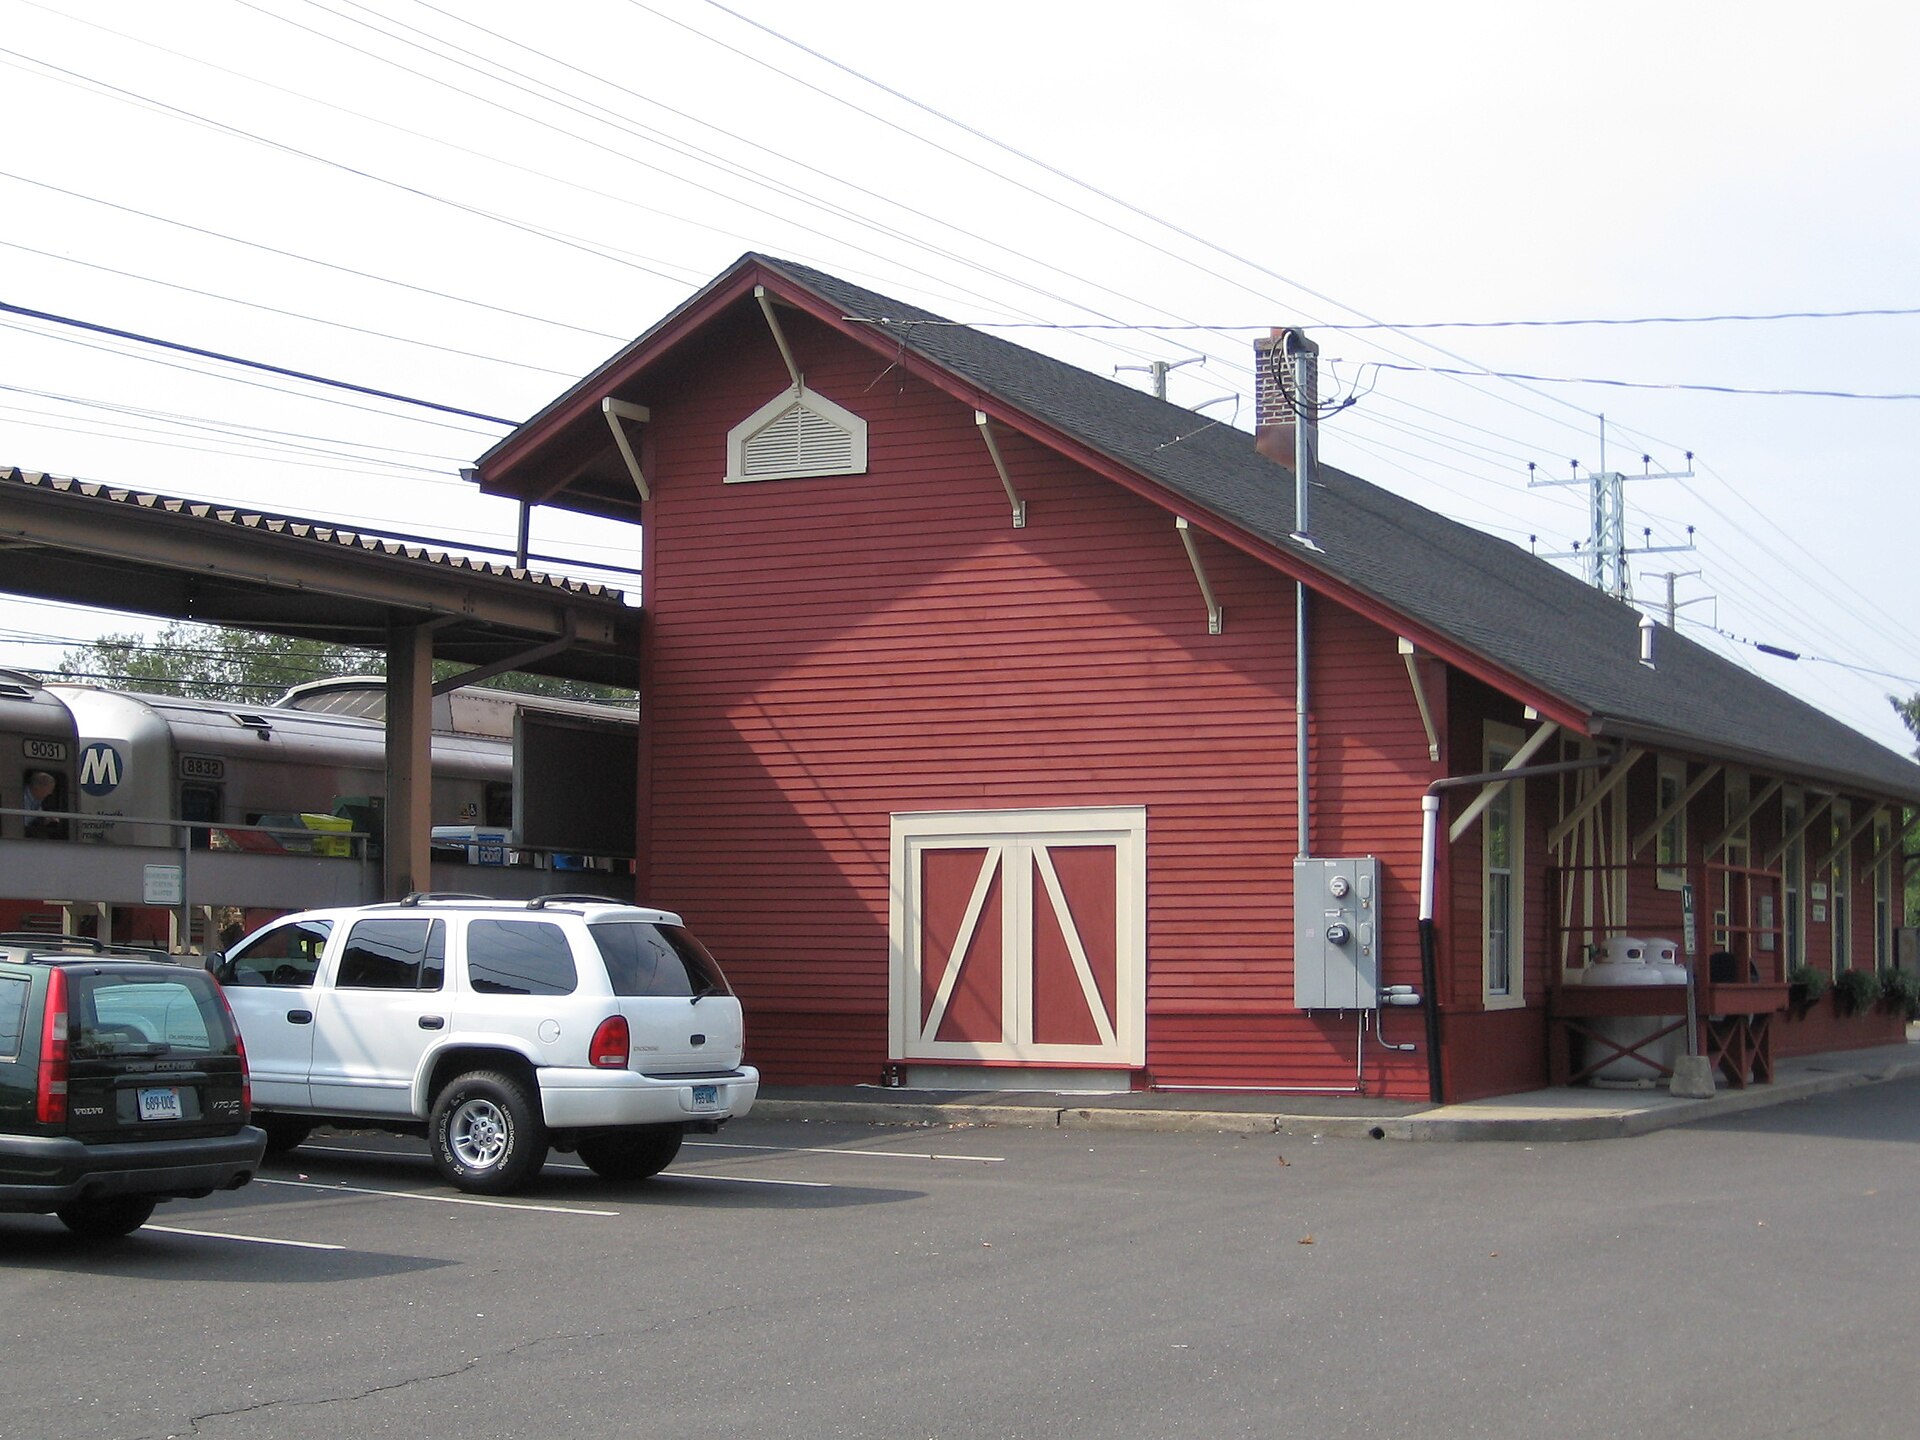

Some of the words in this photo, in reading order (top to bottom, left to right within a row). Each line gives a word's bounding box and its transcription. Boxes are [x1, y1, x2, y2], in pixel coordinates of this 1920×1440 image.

[31, 742, 60, 757] 9031
[80, 748, 118, 785] M
[187, 759, 219, 774] 8832
[73, 1107, 104, 1116] VOLVO
